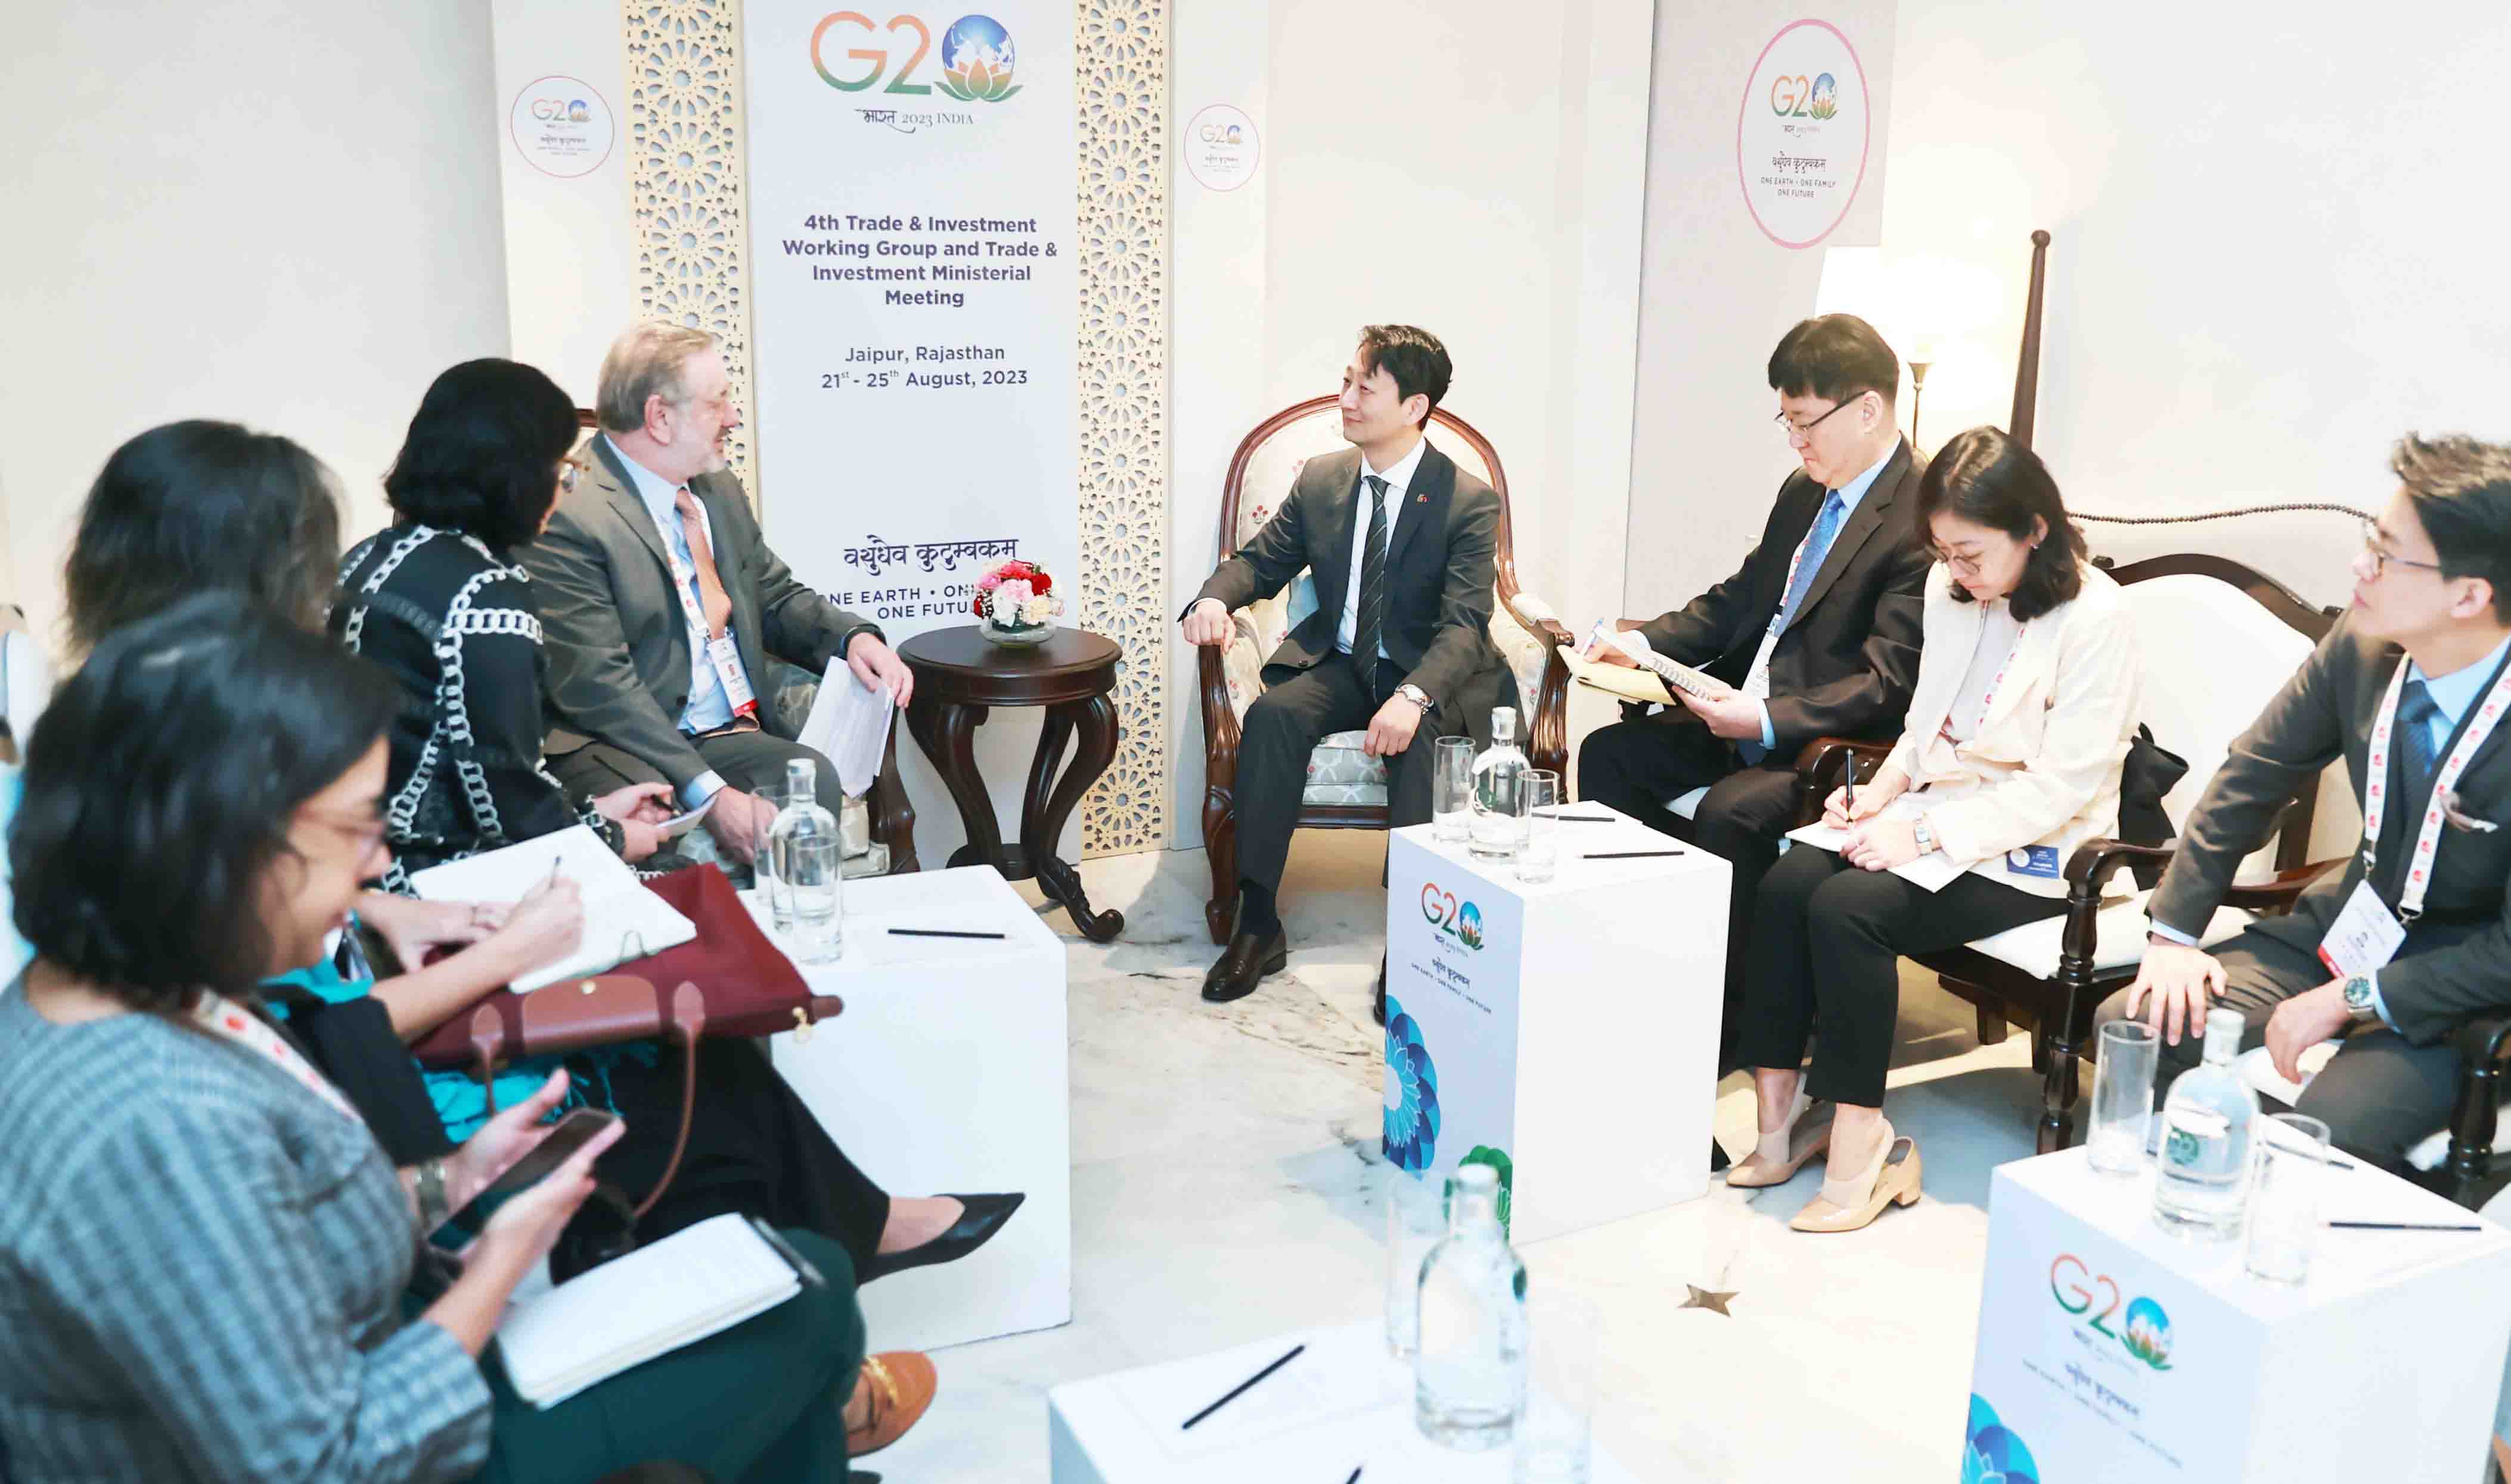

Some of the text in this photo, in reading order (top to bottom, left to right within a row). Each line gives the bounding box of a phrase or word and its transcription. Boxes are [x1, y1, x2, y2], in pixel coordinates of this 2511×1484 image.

[901, 113, 934, 128] 2023
[936, 112, 974, 125] INDIA
[803, 214, 1037, 233] 4th Trade & Investment
[781, 239, 1058, 260] Working Group and Trade &
[812, 265, 1031, 281] Investment Ministerial
[885, 289, 964, 308] Meeting
[845, 344, 1005, 365] Jaipur, Rajasthan
[821, 371, 849, 389] 21st
[866, 370, 899, 388] 25th
[905, 371, 977, 389] August,
[982, 370, 1028, 385] 2023
[829, 592, 853, 605] NE
[860, 587, 921, 603] EARTH
[877, 601, 973, 619] ONE FUTU
